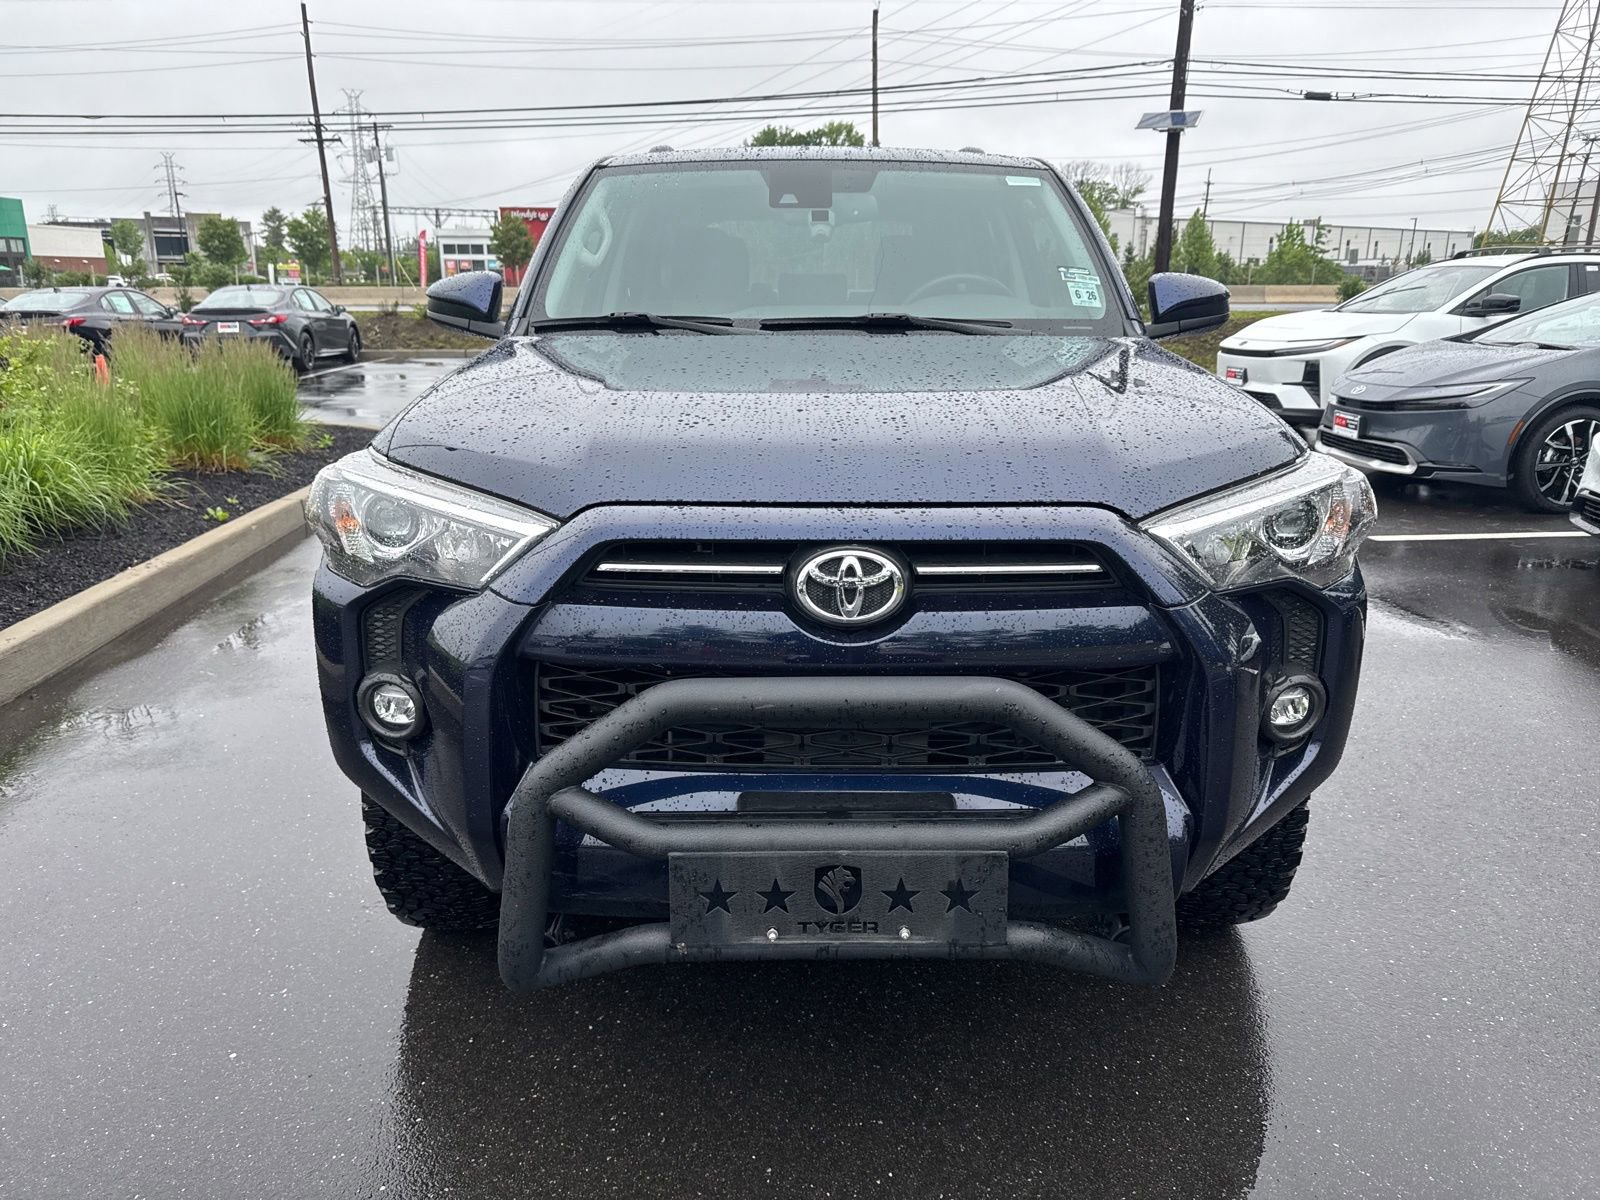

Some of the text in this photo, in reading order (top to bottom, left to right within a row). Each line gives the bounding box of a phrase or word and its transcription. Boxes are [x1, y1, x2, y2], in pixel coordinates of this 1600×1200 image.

[1075, 289, 1097, 301] 6 26
[797, 921, 879, 934] TYGER
